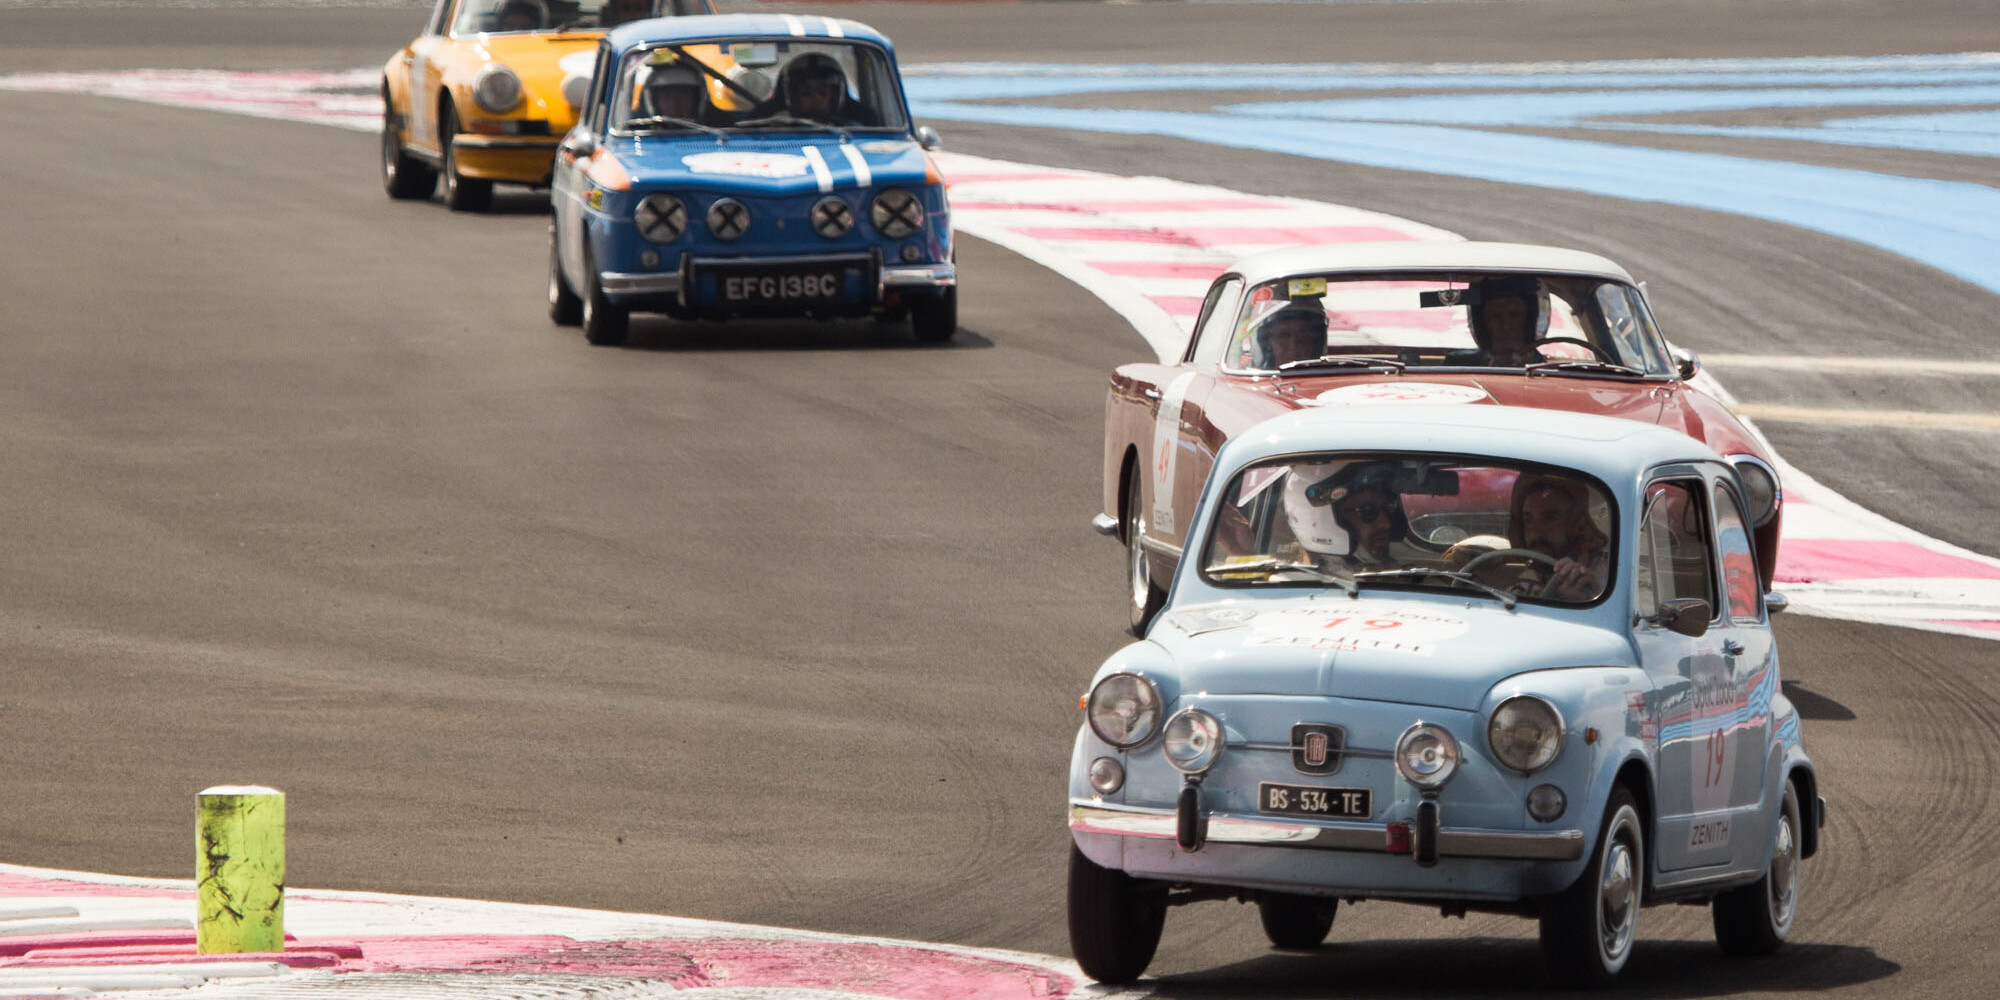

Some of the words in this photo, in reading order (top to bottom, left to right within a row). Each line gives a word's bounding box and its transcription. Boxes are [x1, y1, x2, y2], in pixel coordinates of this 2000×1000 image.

[1322, 616, 1403, 632] 19
[1260, 636, 1422, 652] ZENITH
[1705, 727, 1725, 788] 19
[1691, 820, 1729, 846] ZENITH
